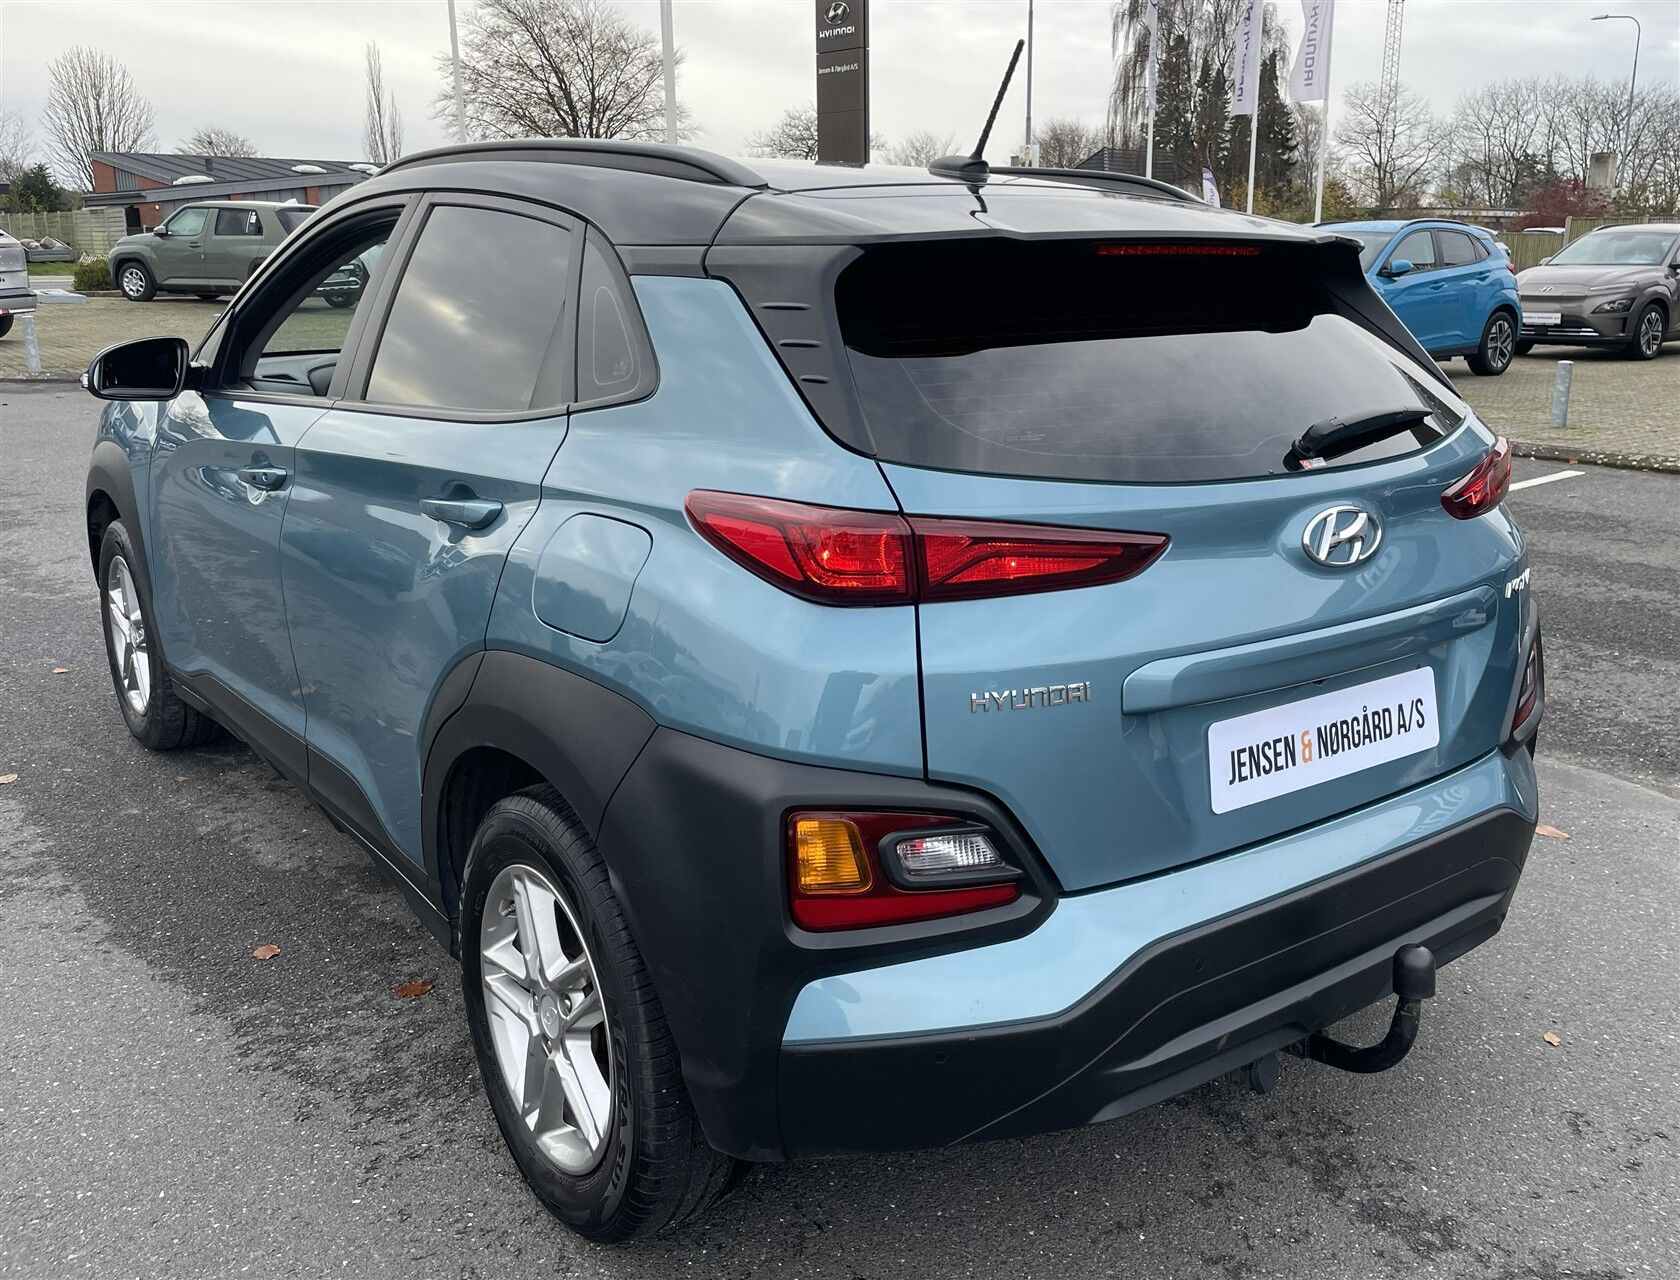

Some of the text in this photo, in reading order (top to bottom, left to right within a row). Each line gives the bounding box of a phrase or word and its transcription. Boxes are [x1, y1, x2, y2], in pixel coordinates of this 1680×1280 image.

[1304, 4, 1320, 87] HYUNDAI
[970, 681, 1091, 713] HYUNDAI
[1229, 698, 1425, 785] JENSEN & NØRGÅRD A/S
